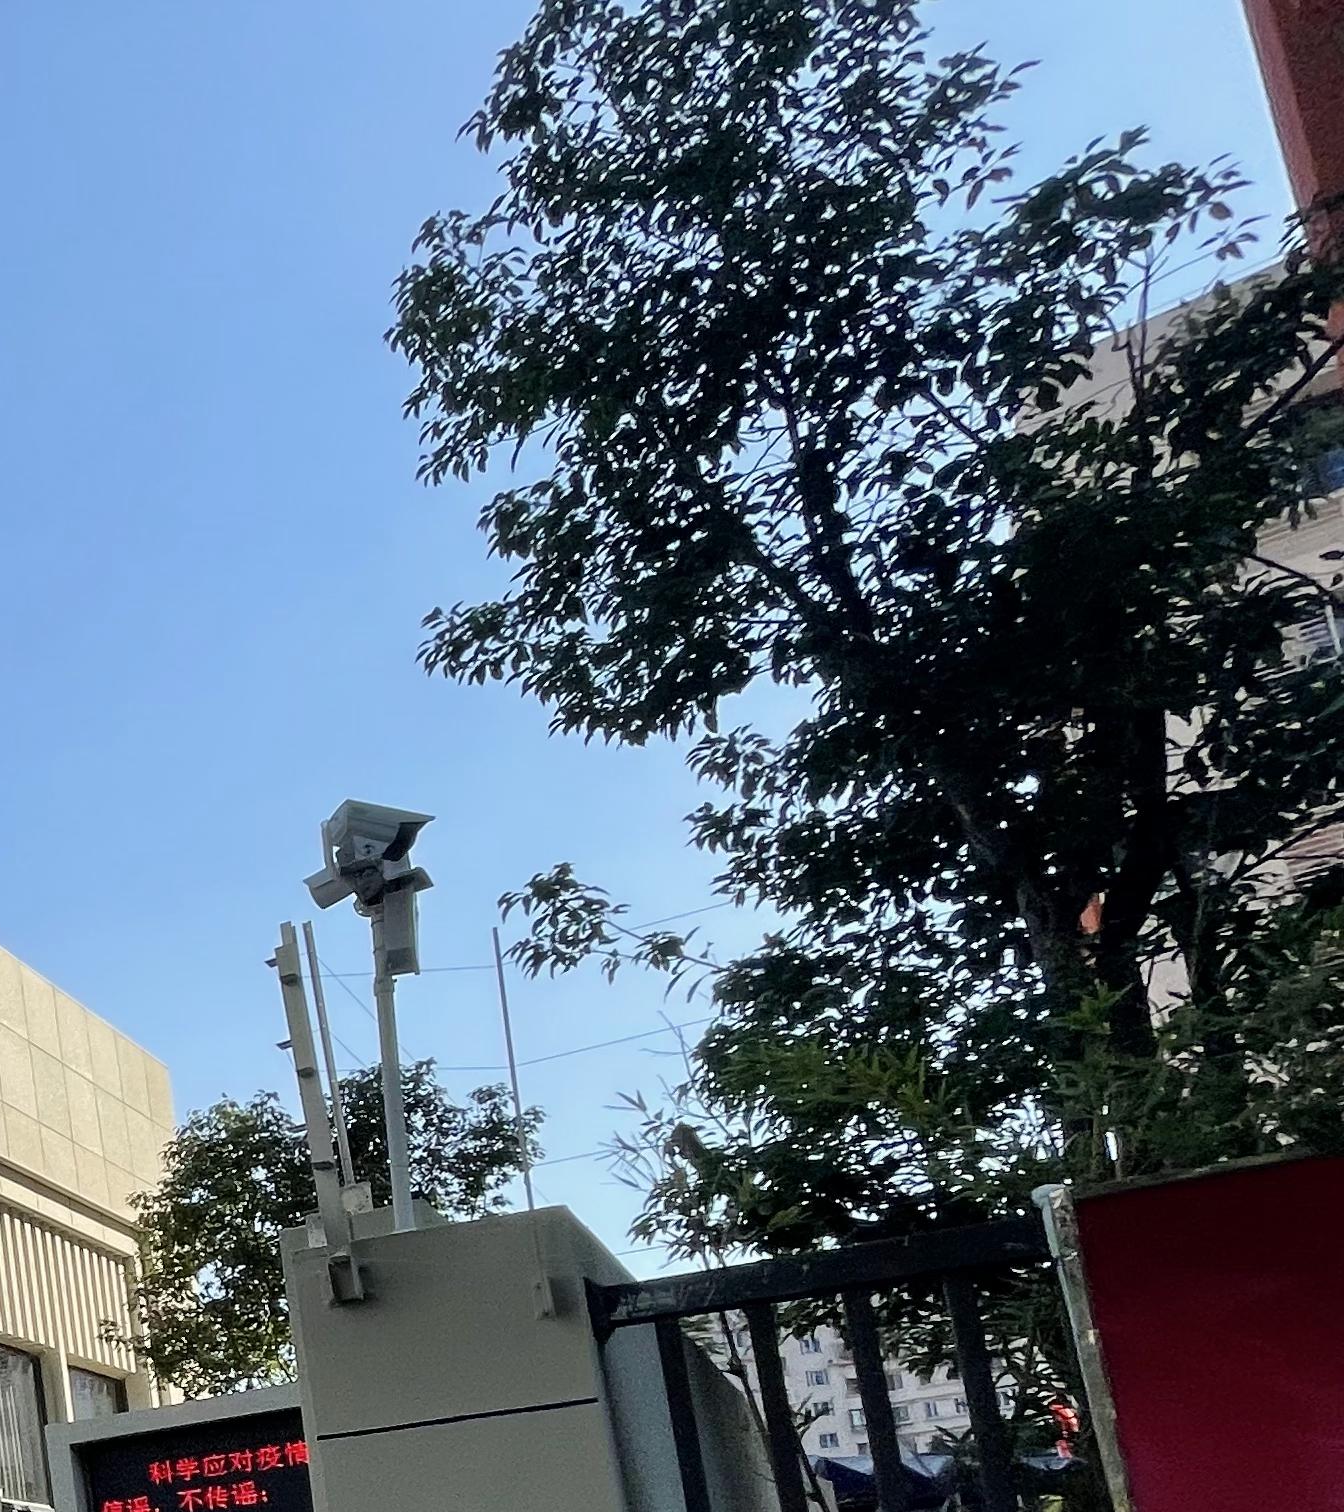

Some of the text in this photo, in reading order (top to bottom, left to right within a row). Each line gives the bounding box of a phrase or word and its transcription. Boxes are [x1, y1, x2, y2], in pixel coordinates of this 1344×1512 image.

[148, 1440, 310, 1485] 科学应对疫情
